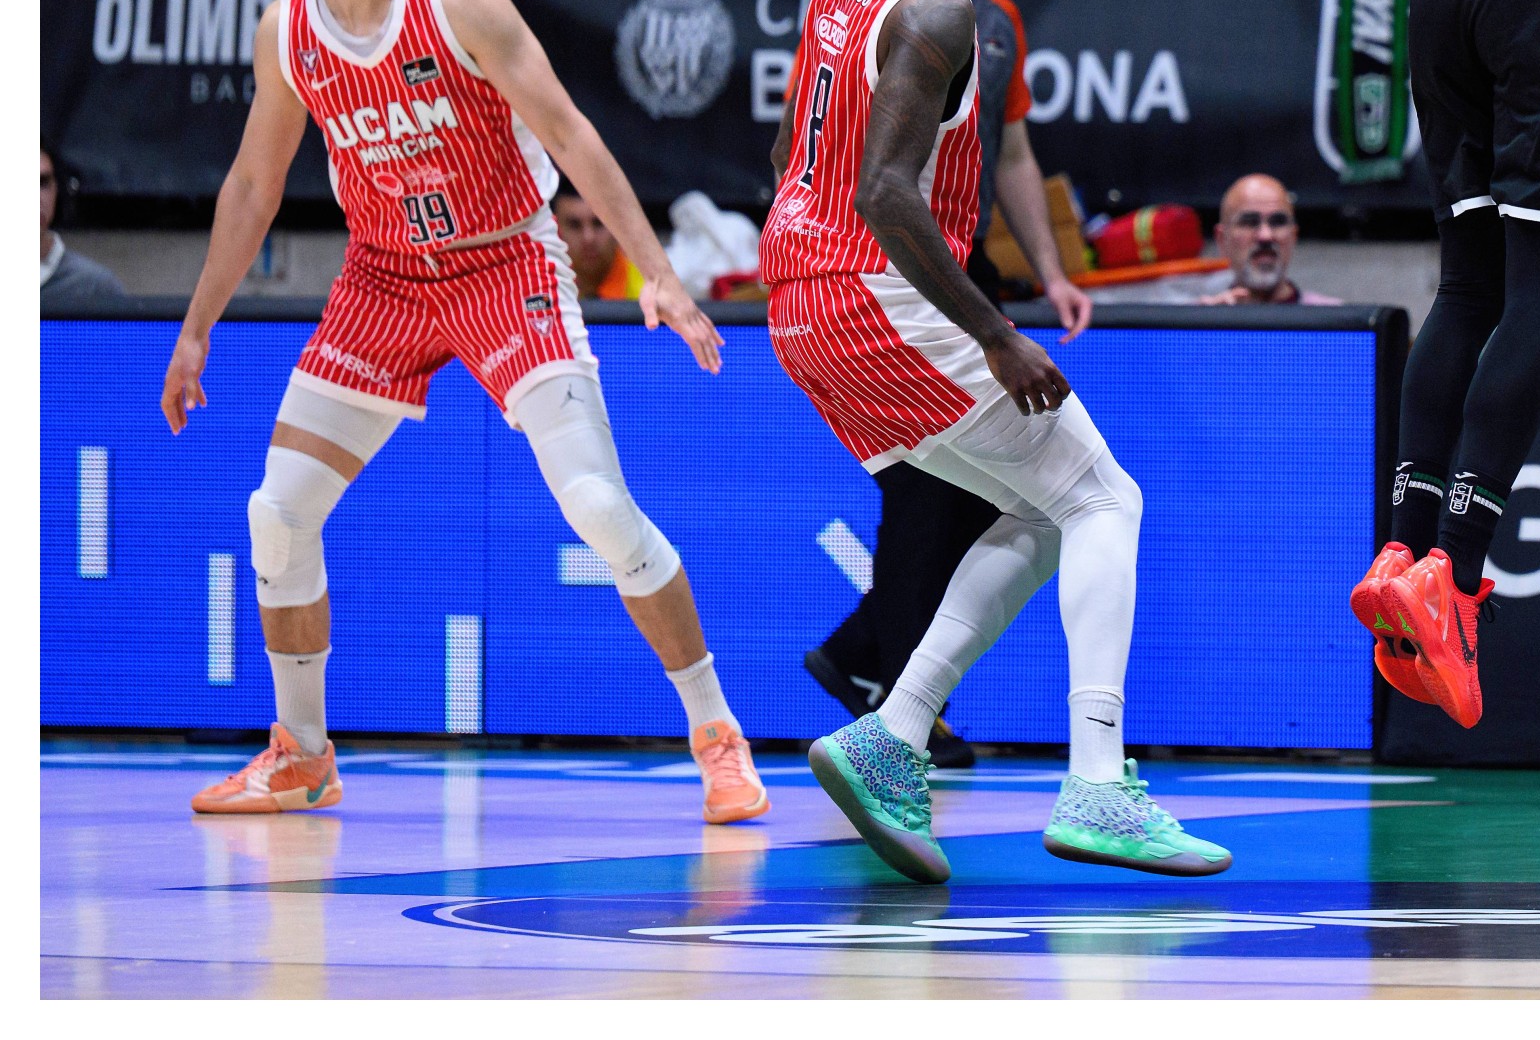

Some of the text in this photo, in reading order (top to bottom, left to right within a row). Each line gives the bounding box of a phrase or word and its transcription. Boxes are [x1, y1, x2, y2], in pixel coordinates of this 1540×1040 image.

[325, 96, 459, 149] UCAM
[359, 134, 445, 167] MURCIA
[402, 190, 459, 246] 99
[318, 343, 394, 388] INVERSUS
